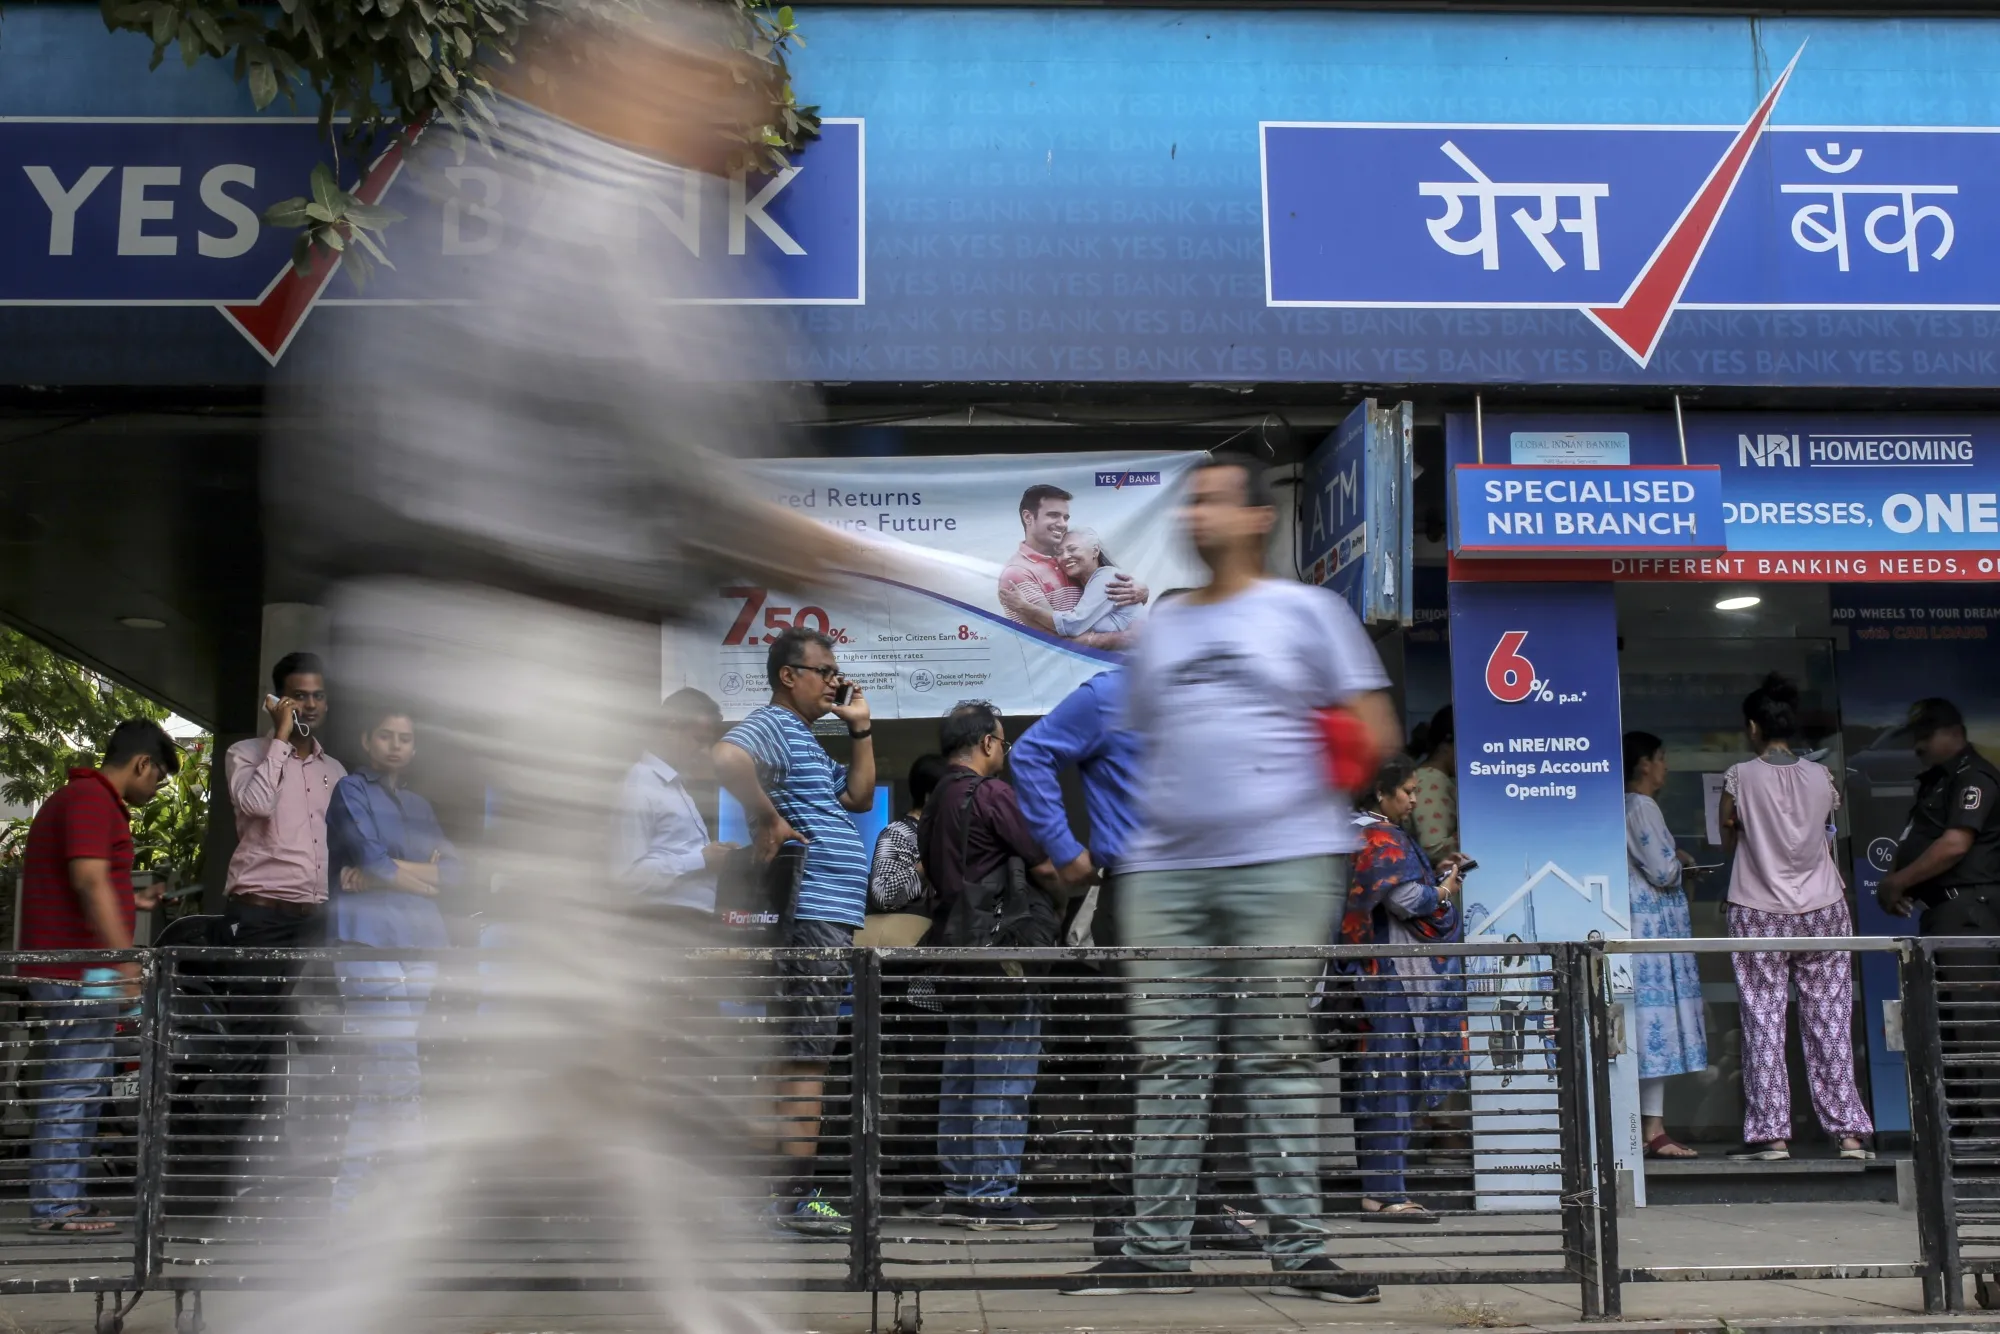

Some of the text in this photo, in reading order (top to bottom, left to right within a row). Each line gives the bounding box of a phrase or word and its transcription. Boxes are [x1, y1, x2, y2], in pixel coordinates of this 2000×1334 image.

[23, 164, 808, 260] YES BNK
[1419, 140, 1609, 272] येस
[1515, 440, 1625, 449] GLOBAL INDIAN BANKING
[1739, 434, 1973, 467] NRI HOMECOMING
[1099, 474, 1157, 484] YES BANK
[827, 487, 921, 508] Returns
[1485, 480, 1695, 503] SPECIALISED
[1310, 459, 1357, 551] ATM
[1723, 493, 1999, 533] DDRESSES, ONE
[878, 513, 957, 532] Future
[1487, 512, 1697, 535] NRI BRANCH
[1612, 559, 1745, 575] DIFFERENT
[1759, 559, 1867, 574] BANKING
[1880, 558, 1967, 576] NEEDS,
[1833, 608, 1856, 619] ADD
[1860, 608, 1905, 619] WHEELS
[1910, 608, 1924, 619] TO
[1929, 608, 1960, 619] YOUR
[878, 633, 902, 642] Senior
[905, 633, 937, 642] Citizens
[938, 632, 957, 641] Earn
[1893, 626, 1928, 639] CAR
[1931, 626, 1988, 639] LOANS
[843, 652, 868, 661] higher
[871, 652, 901, 660] interest
[903, 652, 924, 660] rates
[960, 673, 986, 681] Monthly
[1483, 737, 1590, 753] on NRE/NRO
[1470, 759, 1610, 778] Savings Account
[1505, 782, 1577, 801] Opening
[1629, 1112, 1637, 1133] apply
